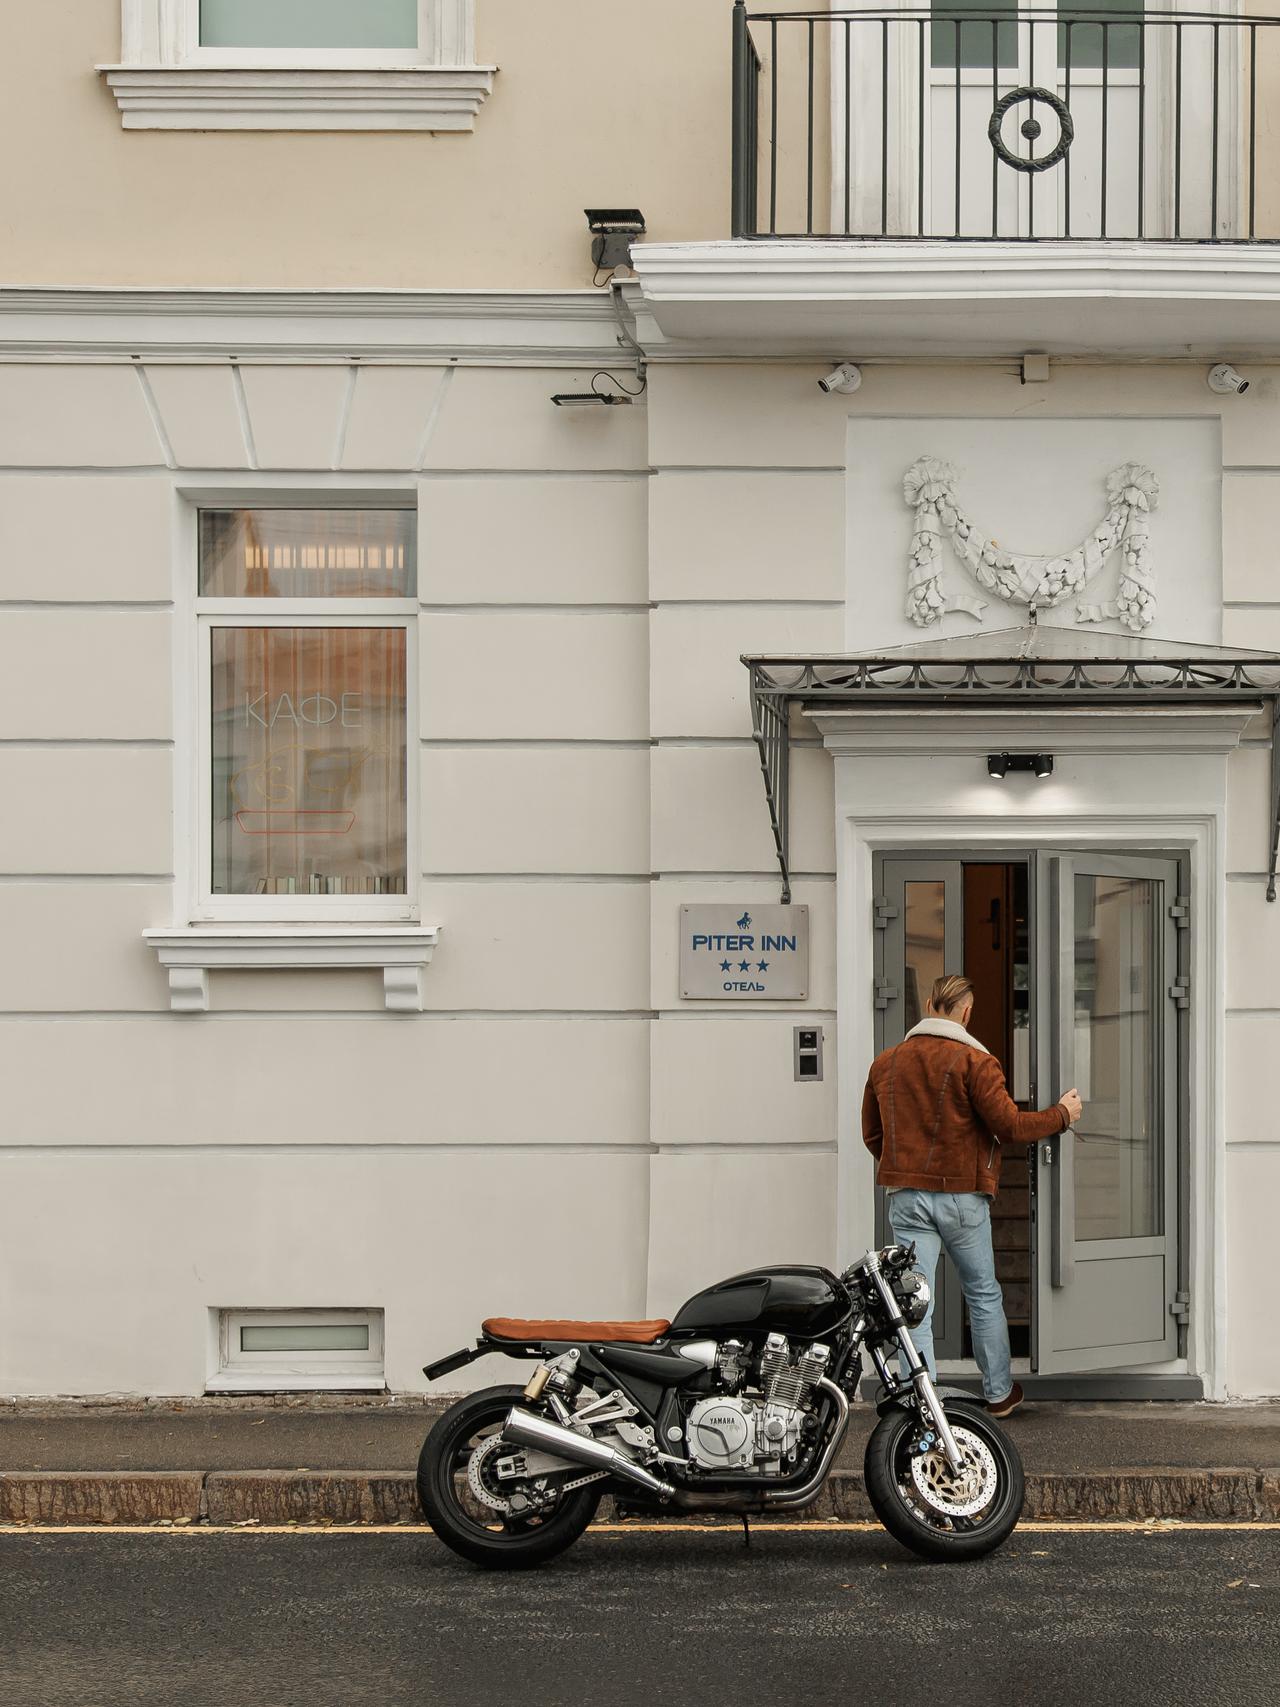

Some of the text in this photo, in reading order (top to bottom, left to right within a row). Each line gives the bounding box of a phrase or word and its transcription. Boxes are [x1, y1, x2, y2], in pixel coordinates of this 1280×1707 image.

[245, 691, 363, 728] КАФЕ
[692, 935, 797, 951] PITER INN
[723, 982, 765, 992] ОТЕЛЬ
[710, 1417, 735, 1425] YAMAHA
